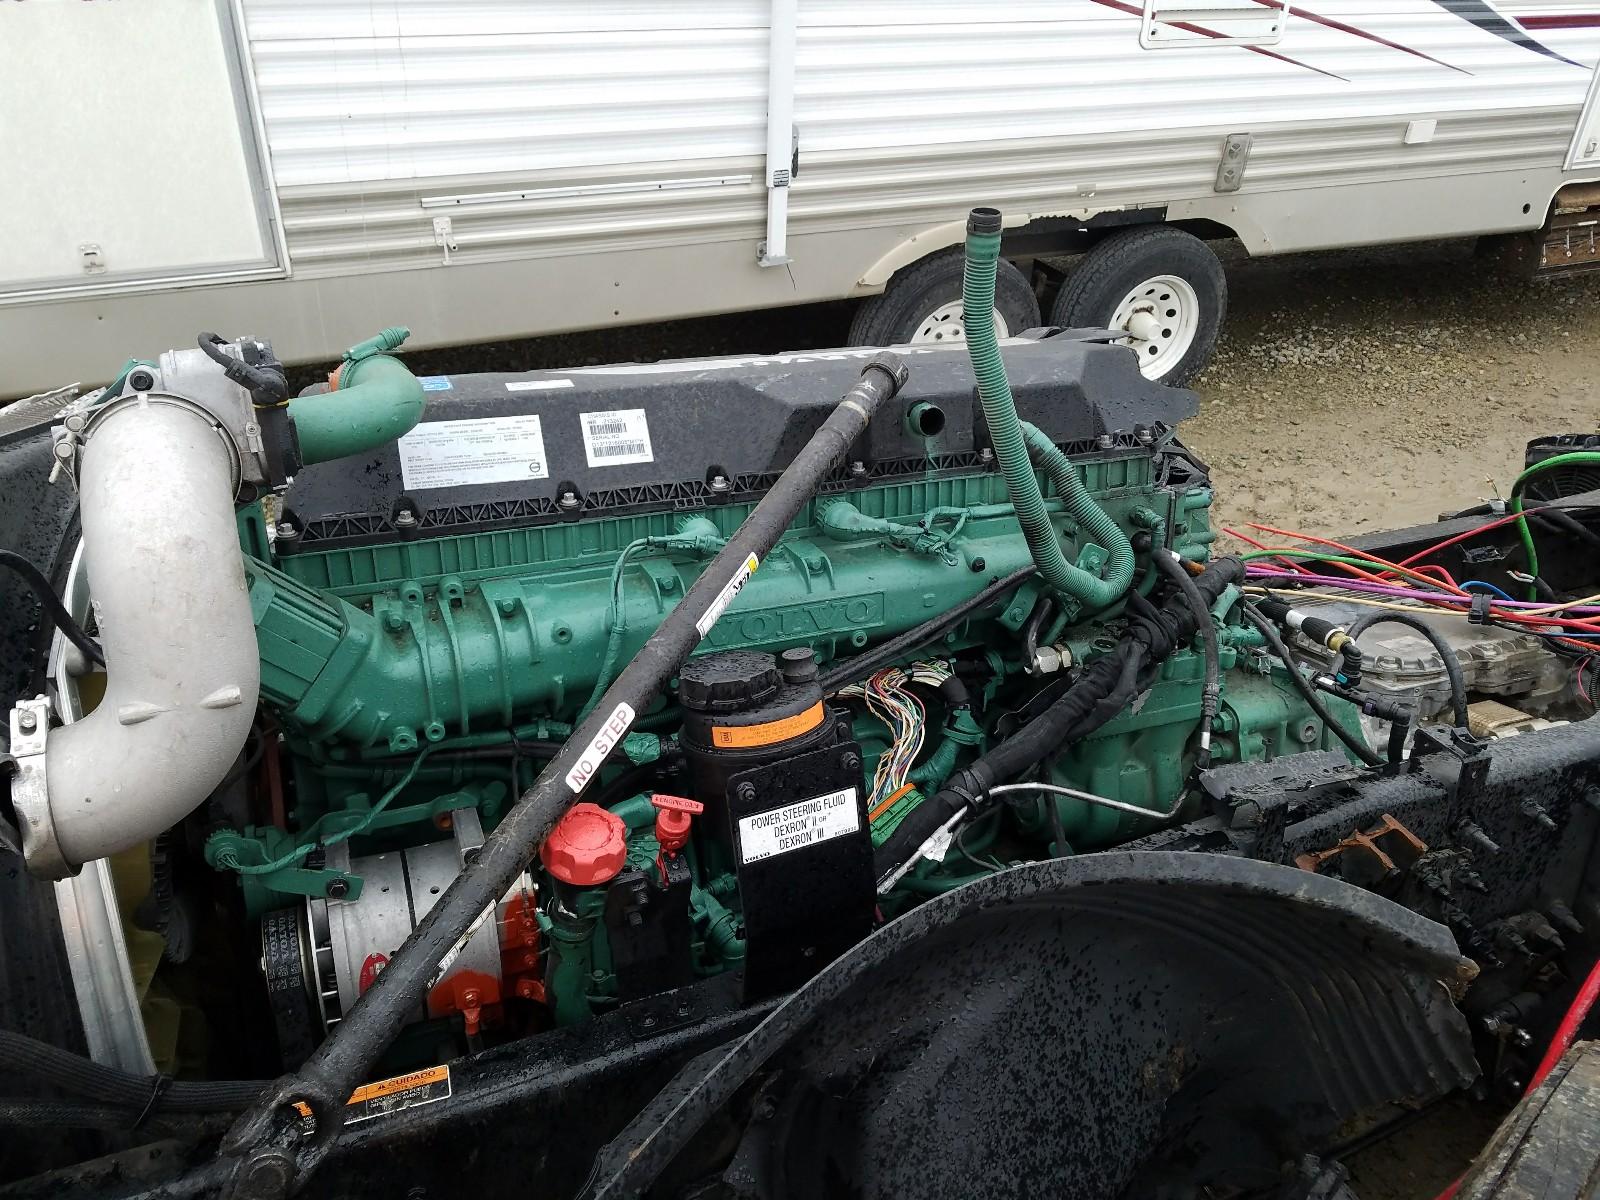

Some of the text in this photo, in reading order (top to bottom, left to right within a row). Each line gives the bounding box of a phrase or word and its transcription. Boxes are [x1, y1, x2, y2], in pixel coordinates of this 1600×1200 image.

[706, 598, 877, 647] VOLVO
[570, 708, 630, 787] NO STEP
[751, 793, 846, 830] POWER STEERING FLUID
[811, 815, 818, 827] II
[818, 815, 827, 823] OR
[816, 827, 825, 840] III
[744, 851, 770, 863] VOLVO
[388, 1070, 436, 1087] CUIDADO
